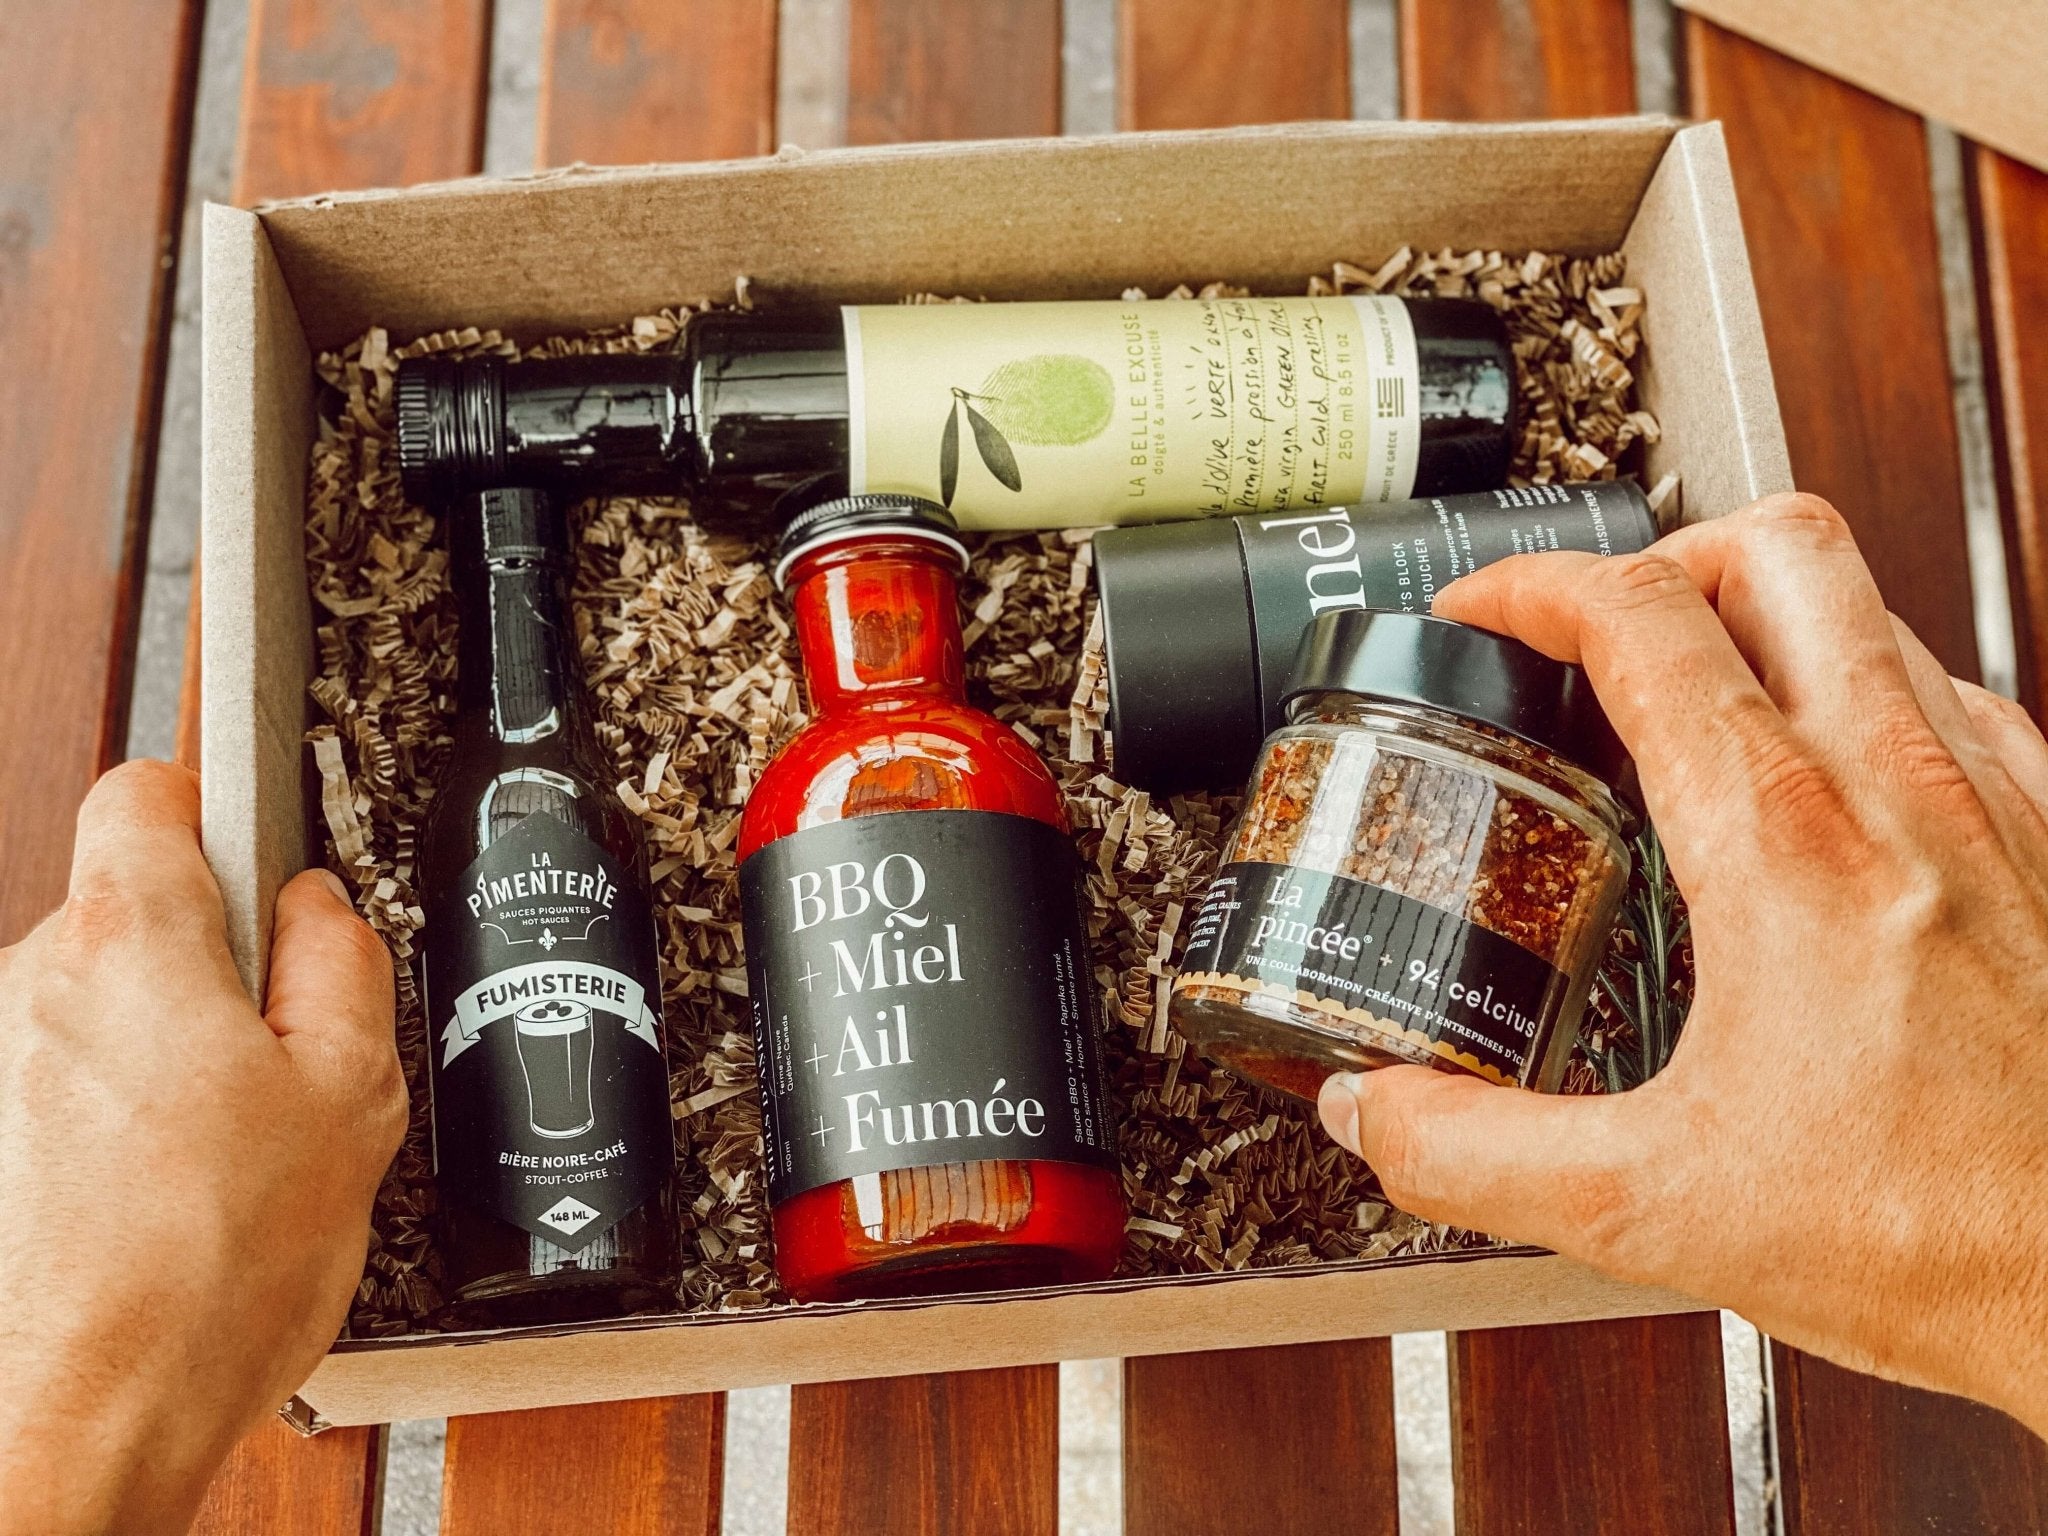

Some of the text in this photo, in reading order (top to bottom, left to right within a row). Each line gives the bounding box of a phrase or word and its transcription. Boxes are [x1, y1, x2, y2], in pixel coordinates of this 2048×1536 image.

[1302, 315, 1337, 383] pressing
[1241, 347, 1275, 422] pression
[1277, 346, 1296, 408] GREEN
[1337, 334, 1353, 461] 250 ml 8.5 fl oz
[1122, 314, 1147, 497] LA BELLE EXCUSE
[1147, 329, 1167, 475] doigté & authenticité
[1278, 425, 1302, 477] virgin
[1444, 528, 1460, 576] Peppercorn
[1534, 524, 1544, 539] this
[1546, 527, 1559, 549] blend
[1392, 541, 1411, 586] BLOCK
[1414, 538, 1435, 603] BOUCHER
[531, 852, 552, 868] LA
[466, 863, 618, 918] PIMENTERIE
[787, 853, 930, 933] BBQ
[1266, 875, 1304, 909] La
[499, 905, 591, 920] SAUCES PIQUANTES
[522, 916, 570, 926] HOT SAUCES
[829, 924, 966, 998] Miel
[1052, 953, 1064, 981] fumé
[1063, 938, 1076, 979] paprika
[476, 973, 627, 1014] FUMISTERIE
[1058, 984, 1069, 1026] Paprika
[1068, 982, 1080, 1020] Smoke
[1246, 955, 1267, 968] UNE
[1269, 959, 1363, 995] COLLABORATION
[1364, 987, 1423, 1016] CRÉATIVE
[1424, 1009, 1504, 1055] D'ENTREPRISES
[1408, 959, 1536, 1039] 94 celcius
[782, 1014, 791, 1051] Canada
[832, 1005, 915, 1077] Ail
[1065, 1039, 1074, 1064] Miel
[1077, 1033, 1086, 1069] Honey
[1068, 1077, 1079, 1104] BBQ
[1082, 1082, 1092, 1115] sauce
[841, 1077, 1047, 1155] Fumée
[1074, 1107, 1084, 1144] Sauce
[1085, 1116, 1095, 1146] BBQ
[498, 1138, 628, 1168] BIÈRE NOIRE-CAFÉ
[784, 1140, 792, 1173] 400ml
[524, 1168, 609, 1185] STOUT-COFFEE
[550, 1210, 590, 1223] 148 ML
